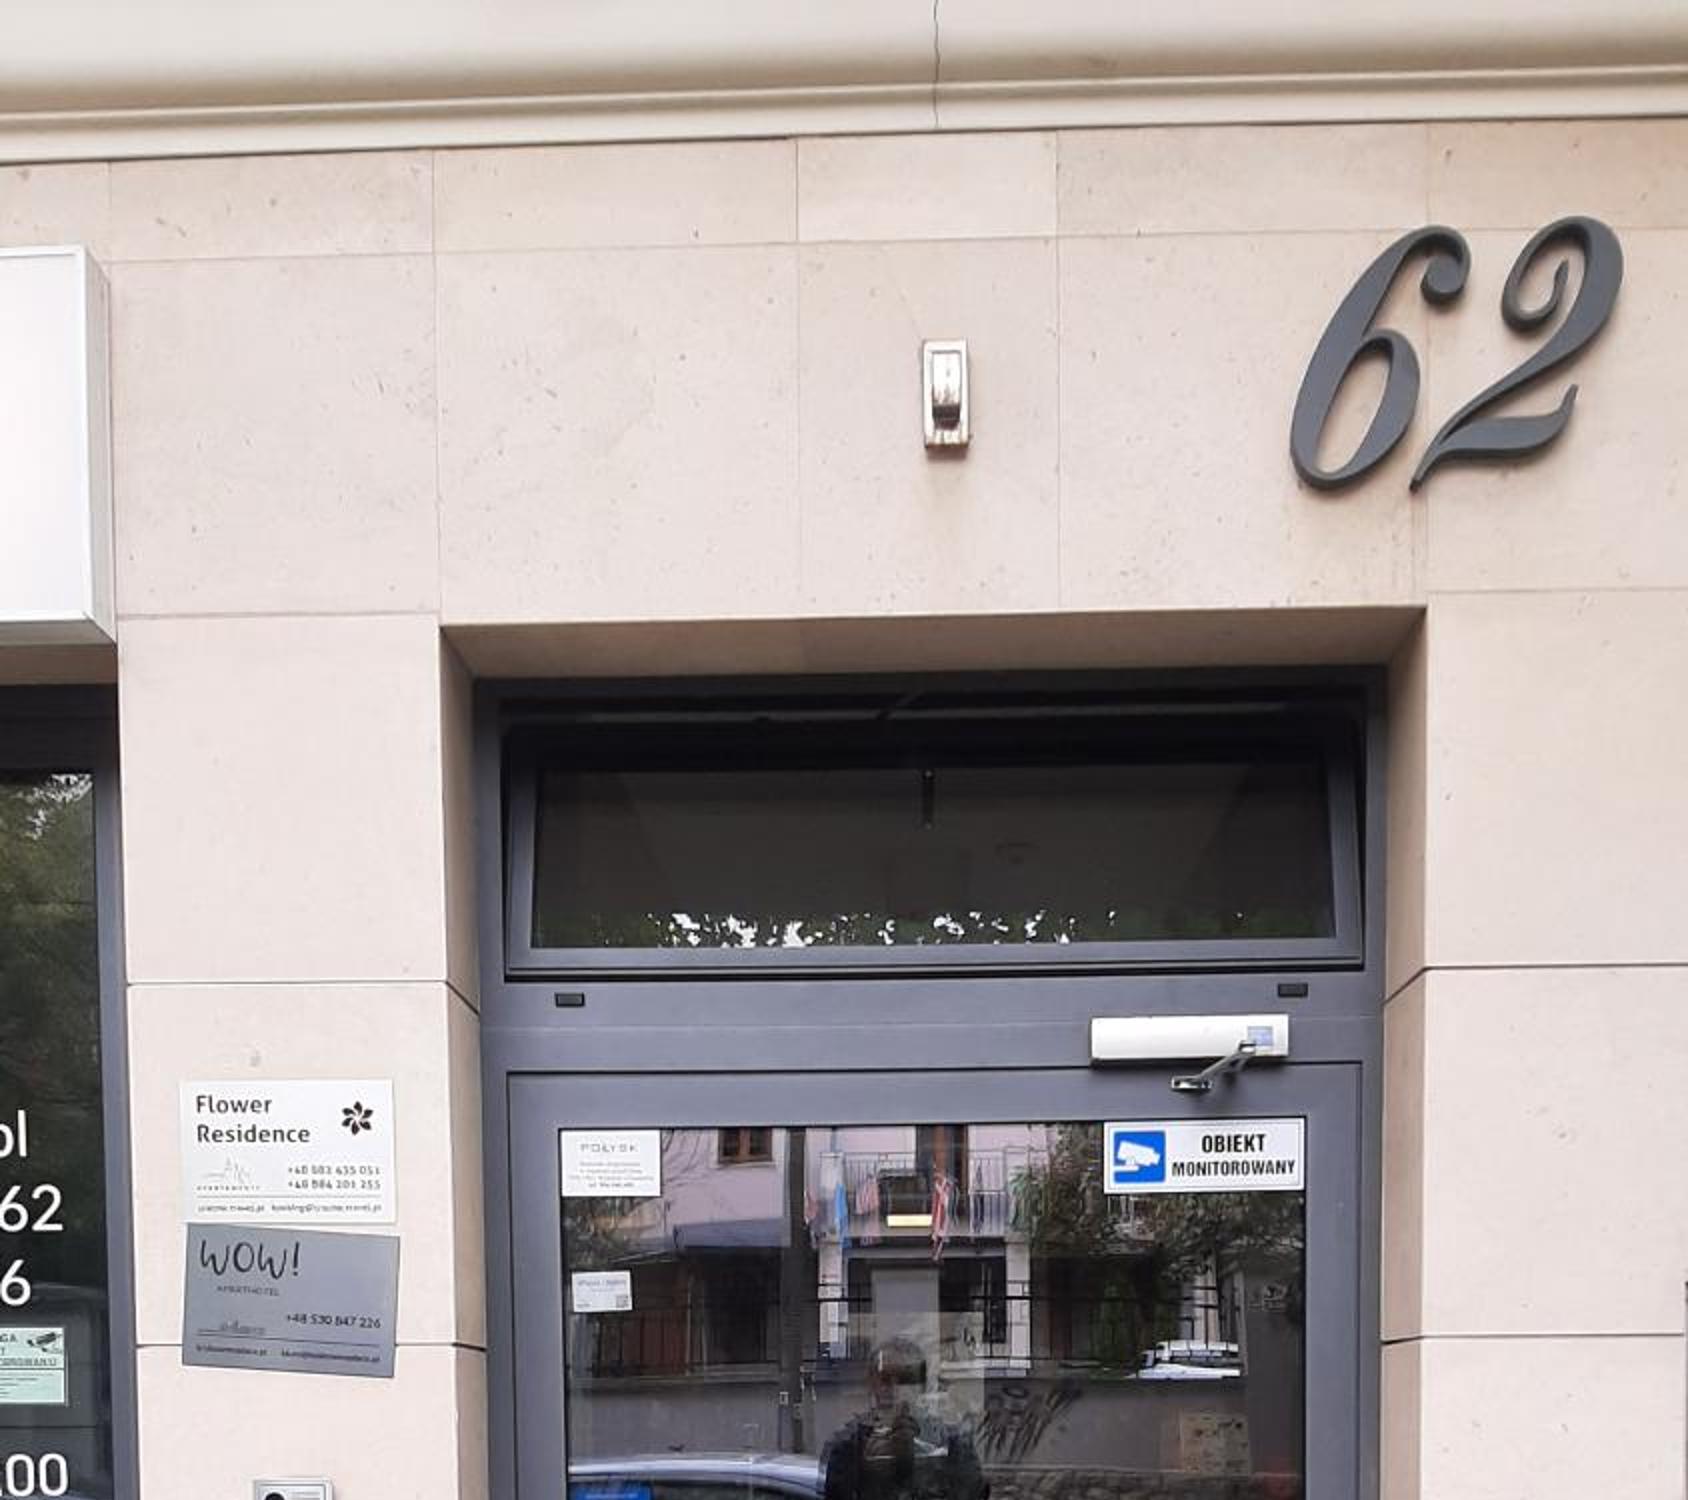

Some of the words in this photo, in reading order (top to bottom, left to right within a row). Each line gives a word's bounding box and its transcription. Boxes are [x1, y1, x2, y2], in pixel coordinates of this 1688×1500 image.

[1289, 214, 1625, 492] 62
[196, 1094, 273, 1114] Flower
[197, 1123, 311, 1143] Residence
[1201, 1133, 1267, 1154] OBIEKT
[1171, 1159, 1296, 1177] MONITOROWANY
[0, 1183, 64, 1233] 62
[200, 1238, 300, 1281] WOW!
